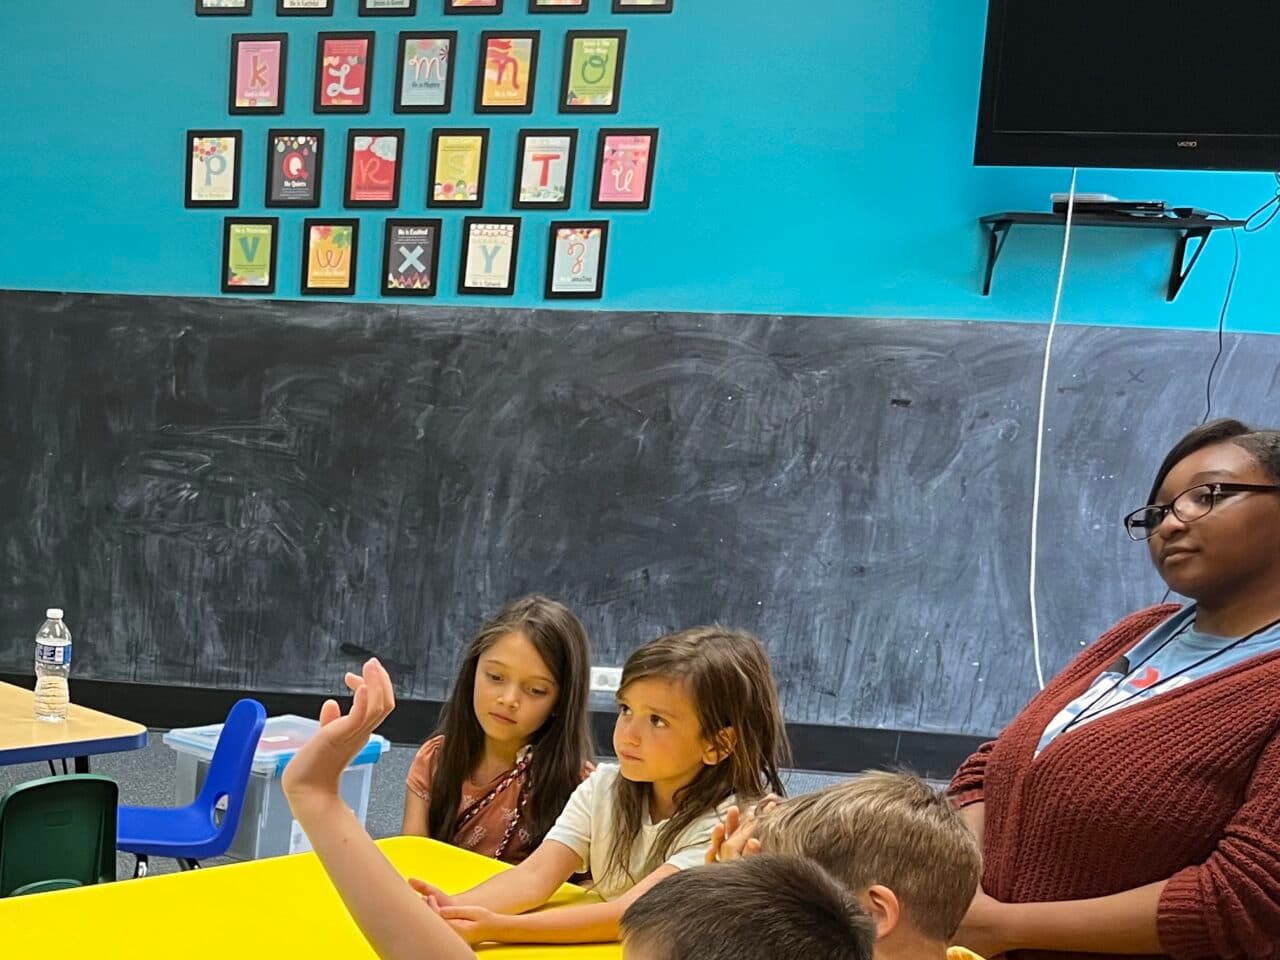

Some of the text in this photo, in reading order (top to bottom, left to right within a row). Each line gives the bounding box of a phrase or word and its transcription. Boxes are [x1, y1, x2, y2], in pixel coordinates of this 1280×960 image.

[283, 151, 310, 180] Q
[531, 152, 561, 187] T
[398, 245, 426, 273] X
[480, 245, 502, 273] Y
